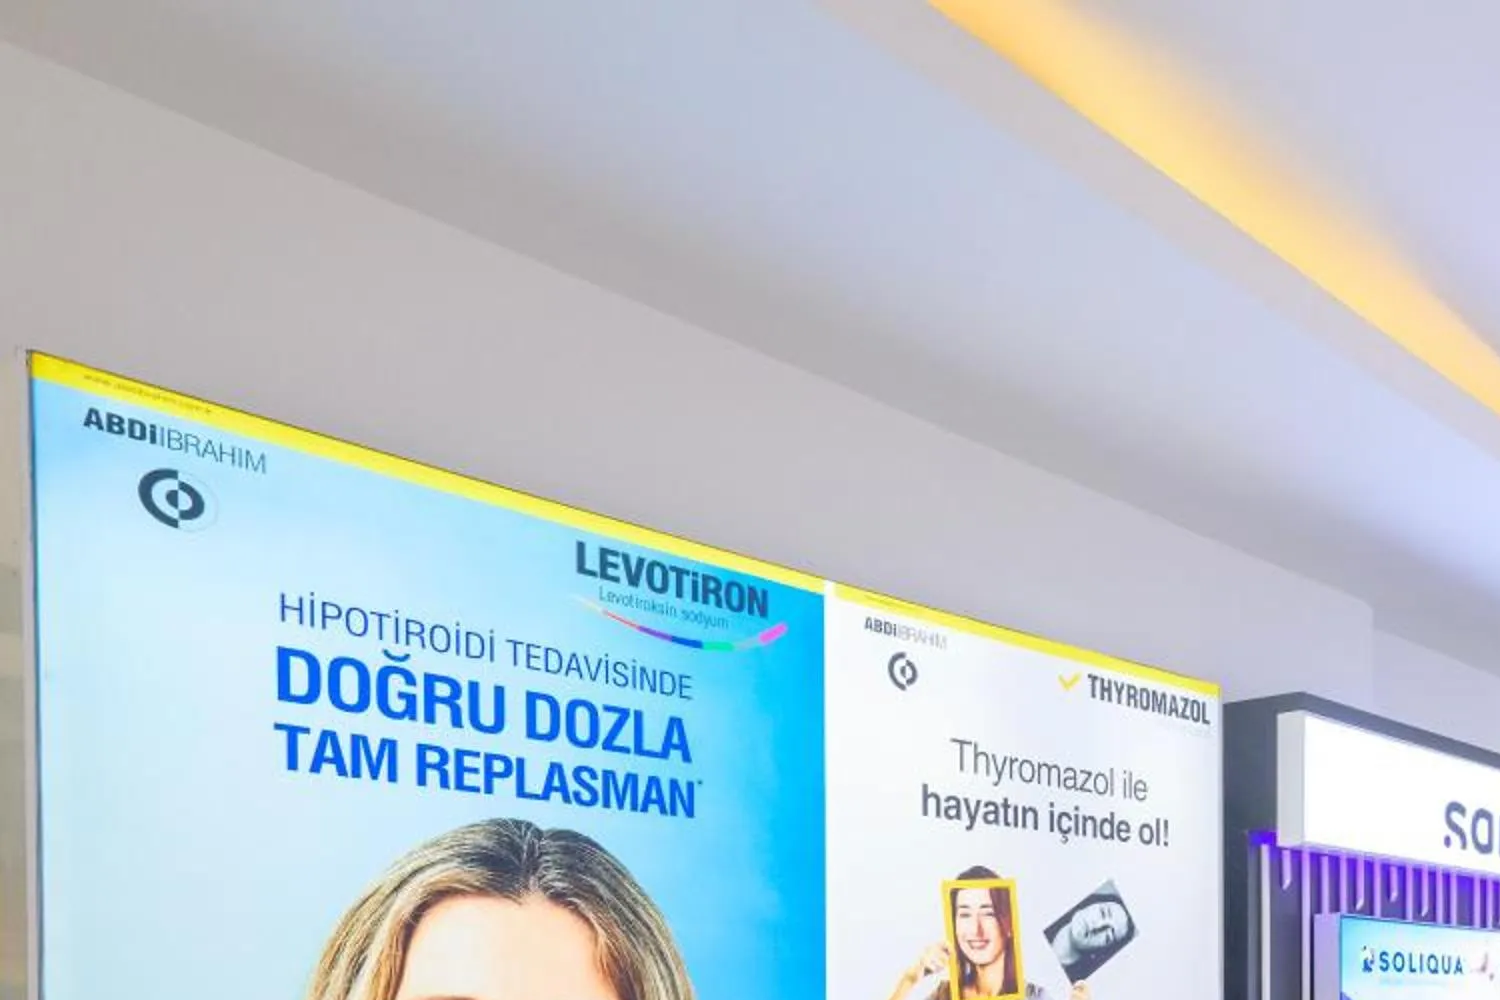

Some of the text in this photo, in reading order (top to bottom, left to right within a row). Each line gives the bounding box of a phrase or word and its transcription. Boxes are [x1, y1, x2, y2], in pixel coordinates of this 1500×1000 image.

[279, 592, 694, 700] HİPOTİROİDİ TEDAVİSİNDE
[276, 646, 692, 764] DOĞRU DOZLA
[1088, 673, 1211, 725] THYROMAZOL
[273, 722, 398, 783] TAM
[950, 737, 1149, 802] Thyromazol ile
[921, 783, 1170, 848] hayatın içinde ol!
[1379, 951, 1464, 975] SOLIQUA
